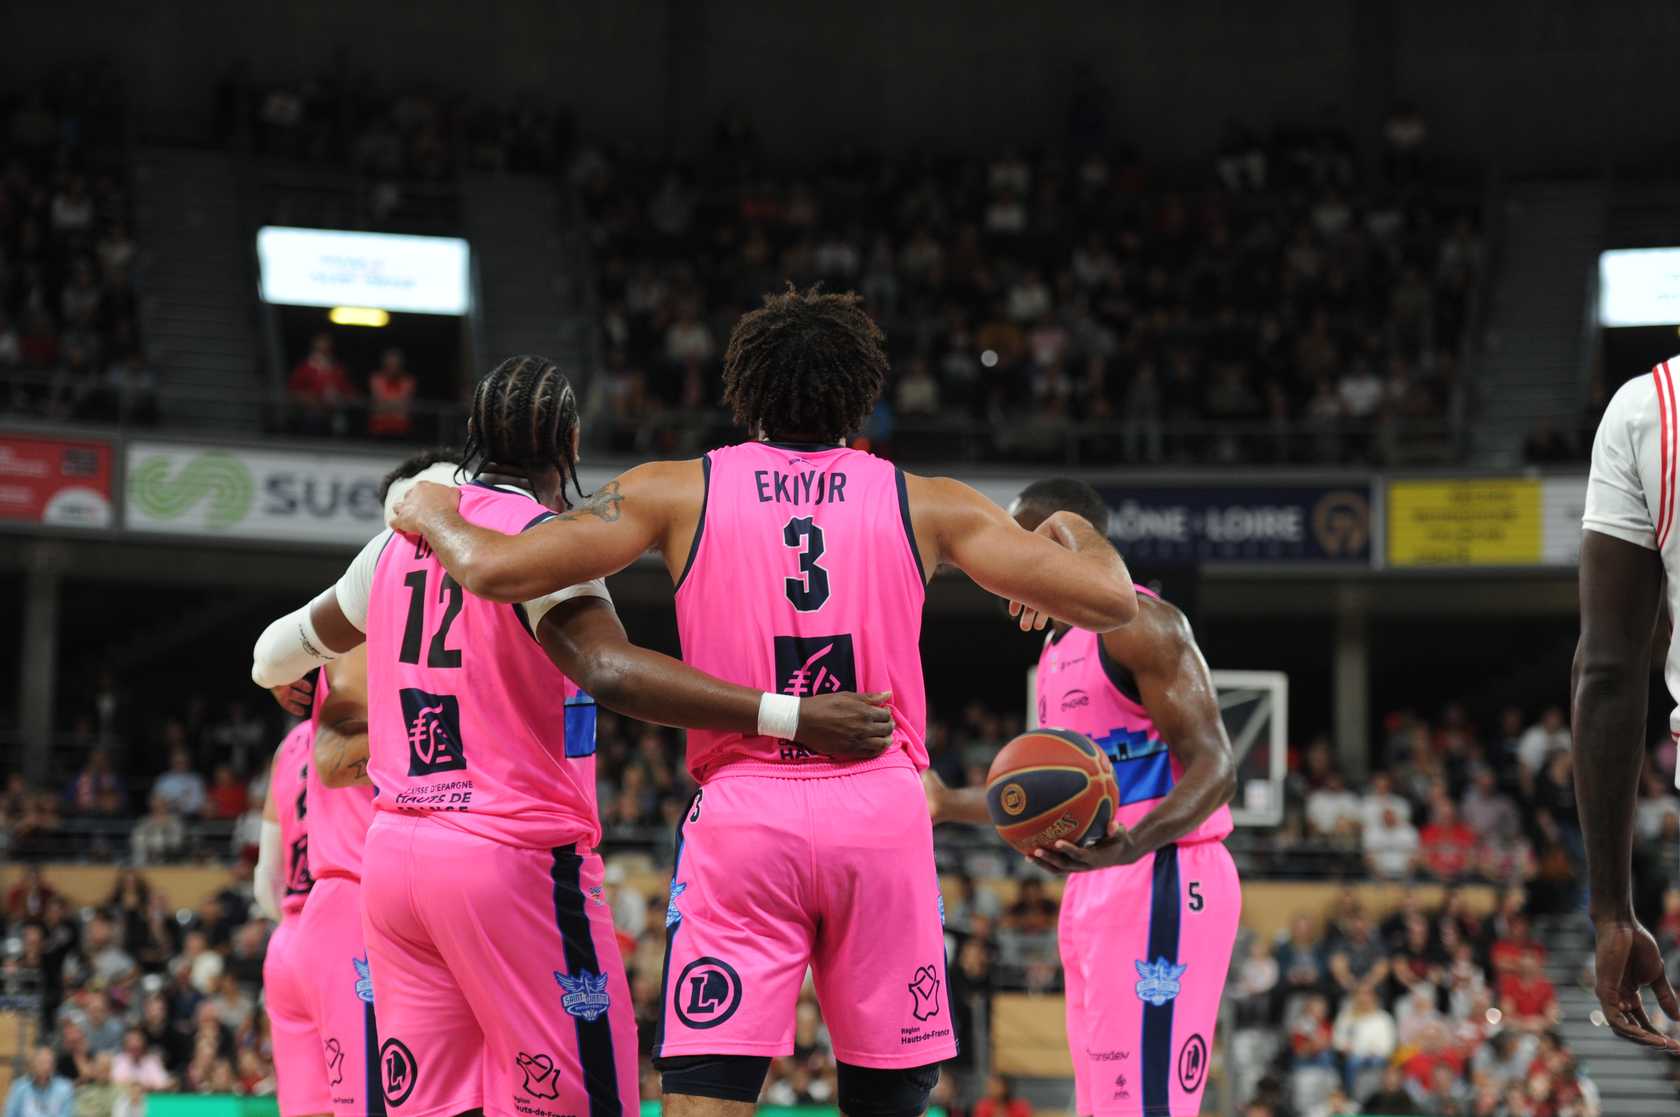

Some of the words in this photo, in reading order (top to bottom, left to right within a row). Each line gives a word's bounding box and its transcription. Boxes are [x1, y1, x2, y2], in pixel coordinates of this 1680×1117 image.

[264, 473, 381, 519] sue
[784, 515, 831, 613] 3
[399, 569, 463, 668] 12
[448, 792, 472, 803] DE
[1188, 881, 1204, 912] 5
